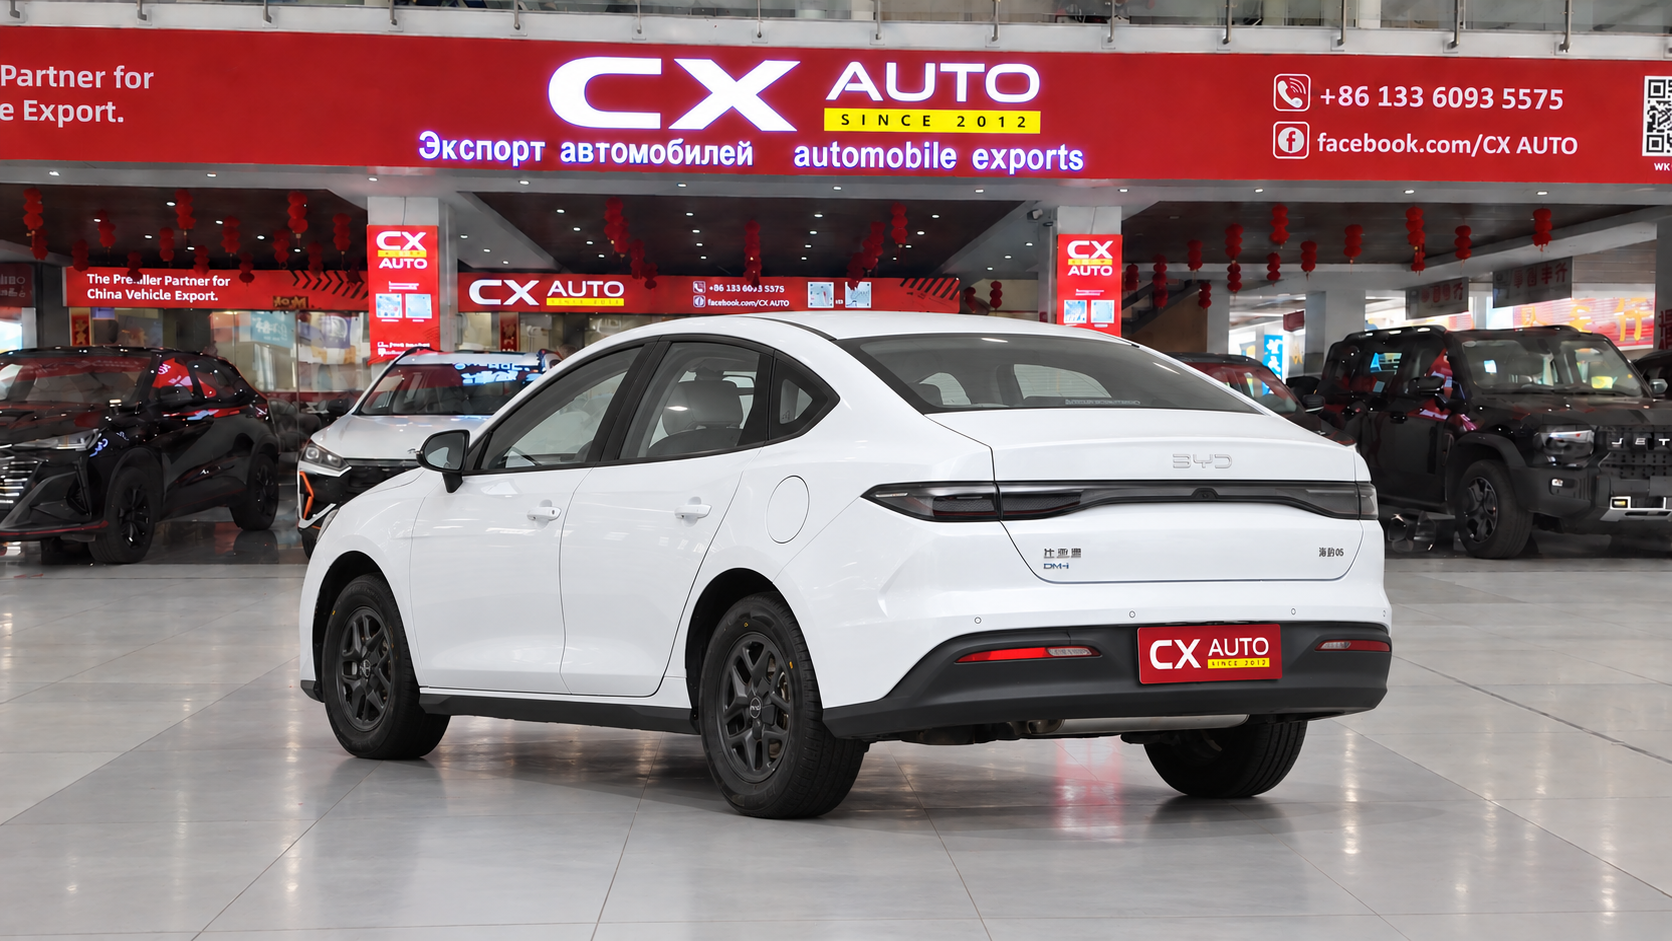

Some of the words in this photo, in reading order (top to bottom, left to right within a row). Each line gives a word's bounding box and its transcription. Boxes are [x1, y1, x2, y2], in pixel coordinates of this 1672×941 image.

[1, 65, 106, 88] Partner
[113, 65, 154, 89] for
[548, 56, 800, 132] CX
[826, 61, 1040, 103] AUTO
[1320, 85, 1369, 107] +86
[1378, 86, 1424, 107] 133
[1432, 87, 1494, 109] 6093
[1502, 88, 1563, 110] 5575
[24, 100, 124, 128] Export.
[841, 114, 931, 127] SINCE
[957, 116, 1026, 128] 2012
[418, 130, 546, 167] Экспорт
[560, 138, 754, 166] автомобилей
[1316, 132, 1510, 157] facebook.com/CX
[1516, 136, 1578, 154] AUTO
[793, 141, 957, 169] automobile
[972, 144, 1084, 175] exports
[376, 231, 427, 251] CX
[1067, 240, 1114, 259] CX
[379, 258, 428, 269] AUTO
[1067, 265, 1113, 277] AUTO
[87, 273, 110, 285] The
[164, 275, 209, 287] Partner
[212, 275, 231, 287] for
[87, 288, 122, 300] China
[125, 288, 171, 300] Vehicle
[175, 290, 219, 303] Export.
[469, 279, 540, 306] CX
[547, 280, 625, 297] AUTO
[769, 299, 790, 307] AUTO
[1172, 453, 1233, 469] BYD
[1149, 638, 1201, 670] CX
[1208, 637, 1269, 656] AUTO
